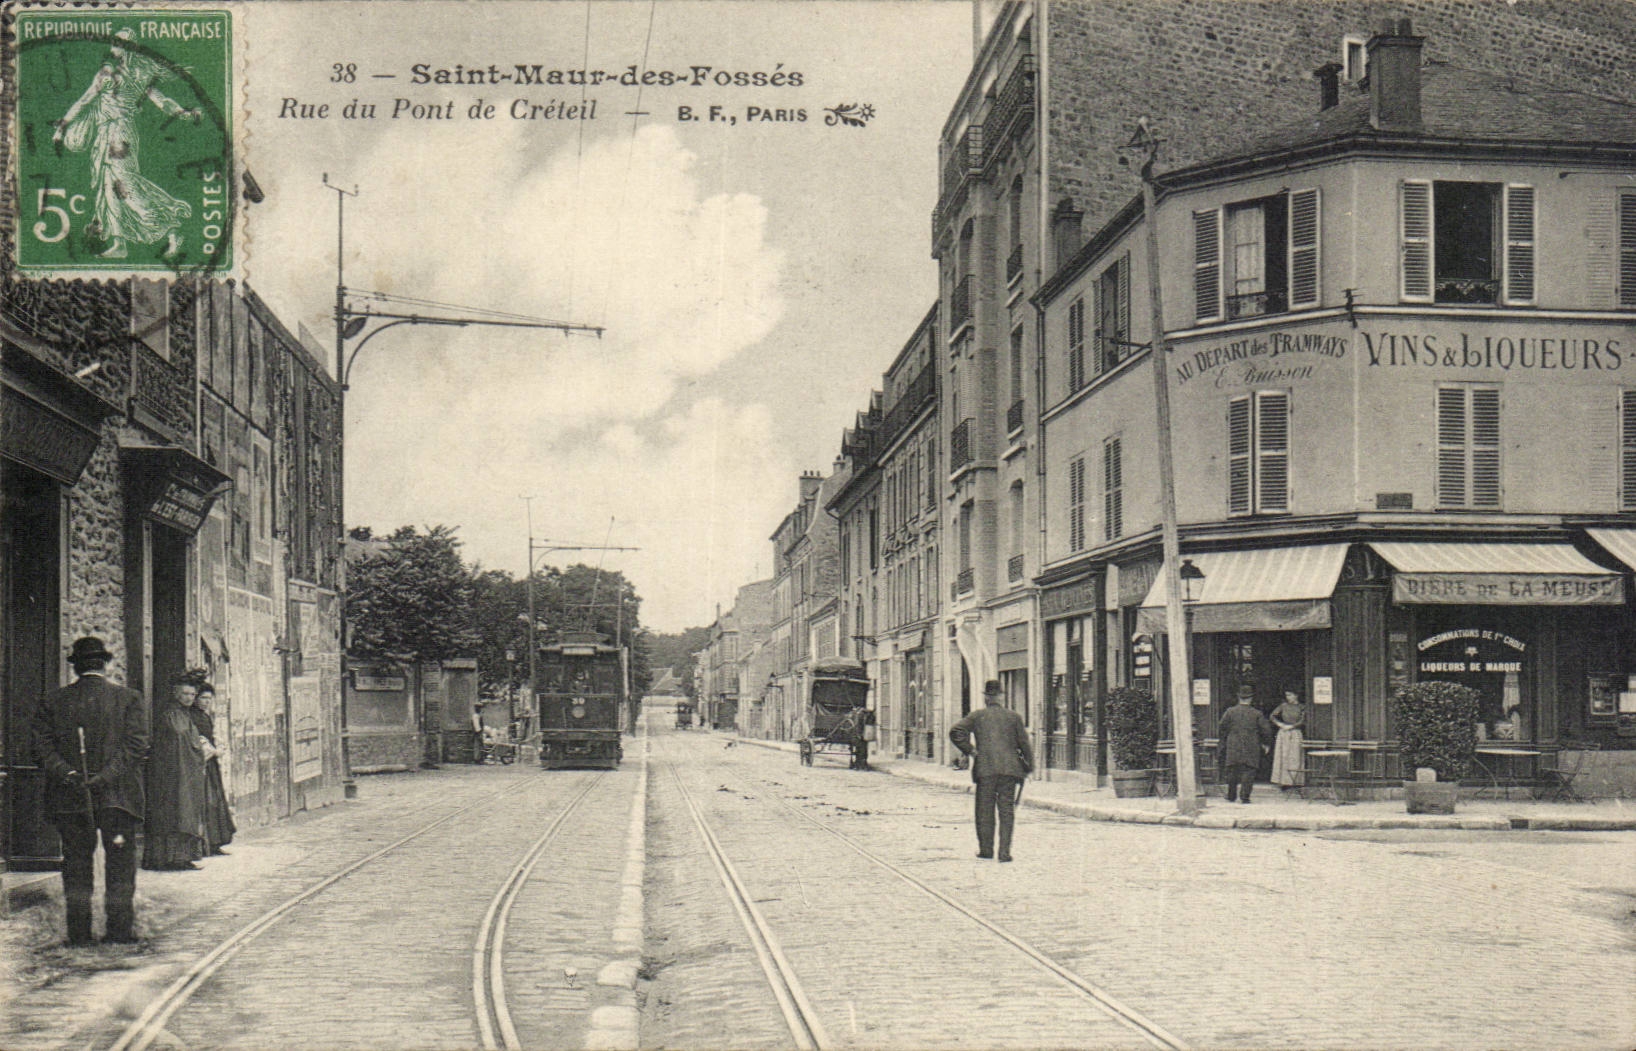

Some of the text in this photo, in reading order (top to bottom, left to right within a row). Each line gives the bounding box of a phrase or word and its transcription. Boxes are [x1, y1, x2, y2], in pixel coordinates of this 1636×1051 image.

[24, 21, 222, 41] REPUBLIQUE FRANÇAISE
[202, 170, 222, 255] POSTES
[1176, 361, 1195, 385] AU
[1250, 339, 1268, 356] des
[1269, 332, 1348, 358] TRAMWAYS
[1361, 332, 1622, 371] VINS & LIQUEURS
[1508, 581, 1537, 597] LA
[1542, 581, 1616, 598] MEUSE
[1482, 630, 1492, 639] DE
[1421, 662, 1522, 672] LIQUEURS DE MARQUE
